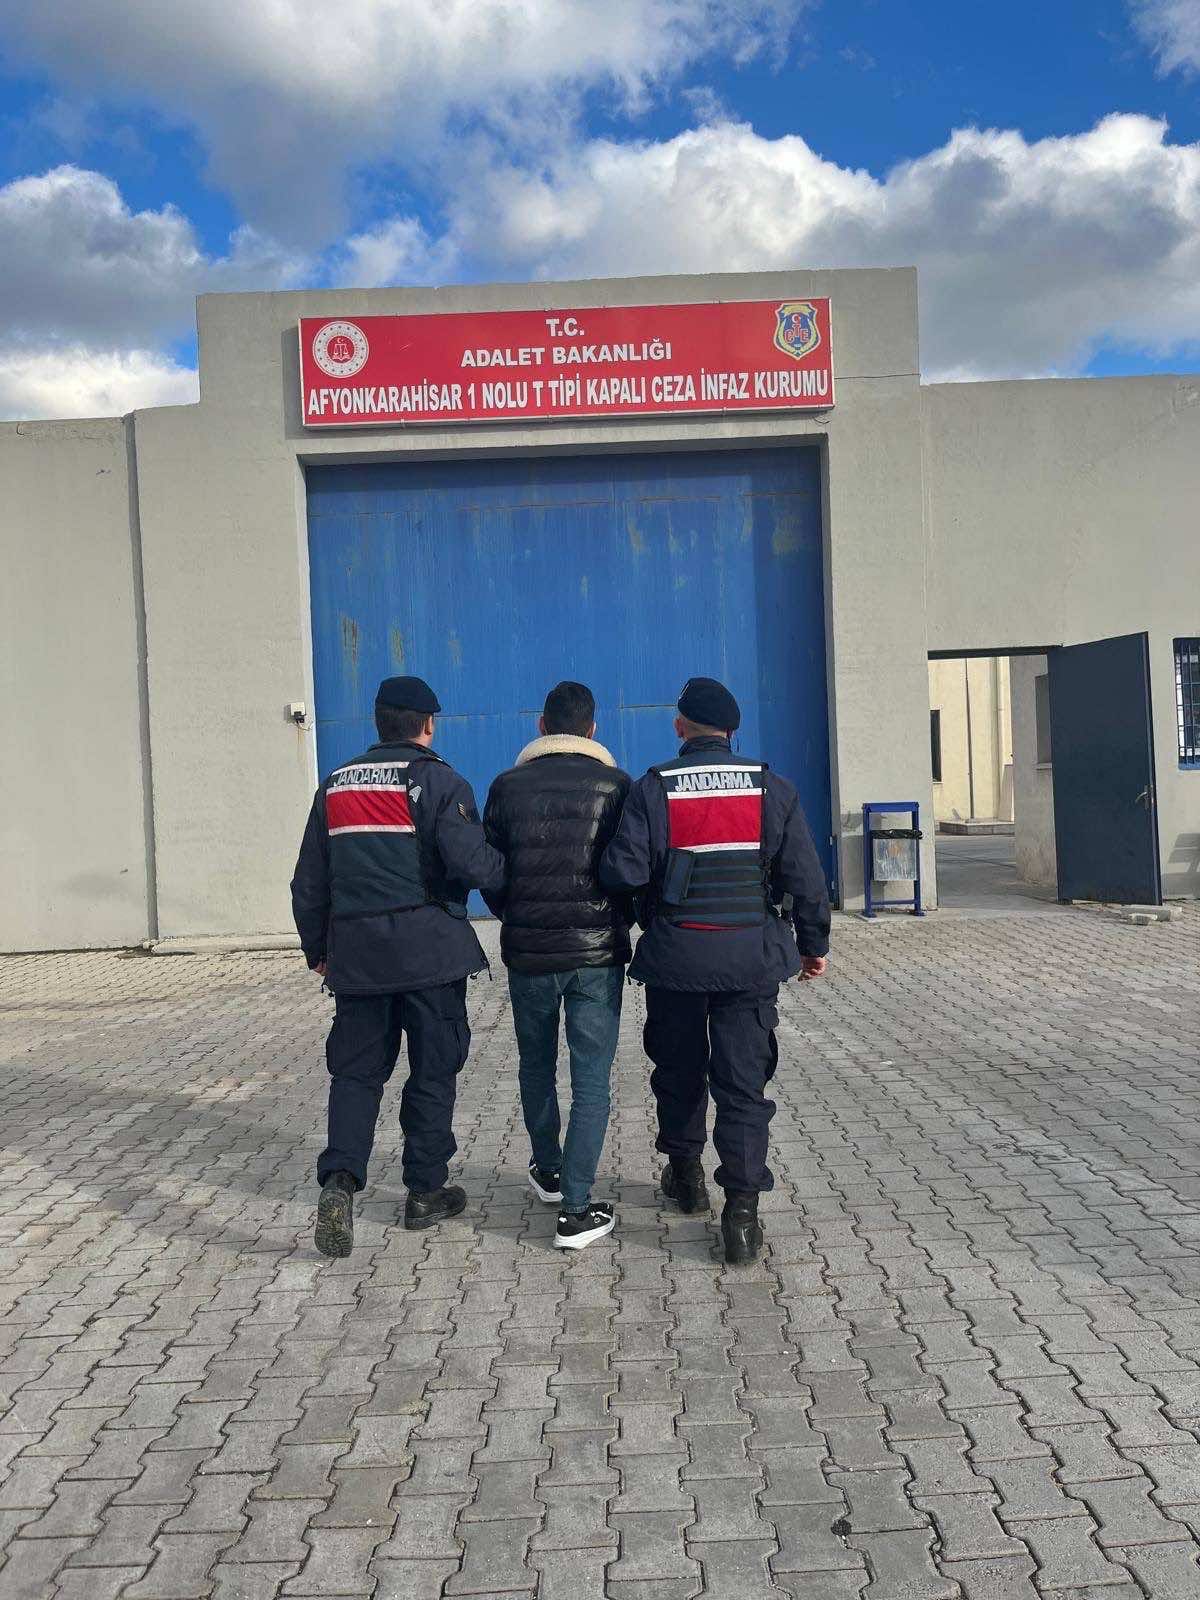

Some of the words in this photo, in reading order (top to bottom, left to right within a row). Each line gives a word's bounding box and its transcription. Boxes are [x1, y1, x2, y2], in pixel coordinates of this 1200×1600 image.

[546, 318, 585, 337] T.C.
[461, 347, 545, 367] ADALET
[552, 338, 672, 364] BAKANLIĞI
[308, 378, 463, 415] AFYONKARAHİSAR
[467, 383, 476, 410] 1
[482, 381, 528, 409] NOLU
[532, 380, 544, 407] T
[548, 373, 581, 407] TİPİ
[586, 376, 646, 405] KAPALI
[651, 374, 697, 402] CEZA
[700, 368, 750, 401] İNFAZ
[754, 369, 828, 399] KURUMU
[333, 768, 400, 786] JANDARMA
[675, 772, 754, 792] JANDARMA
